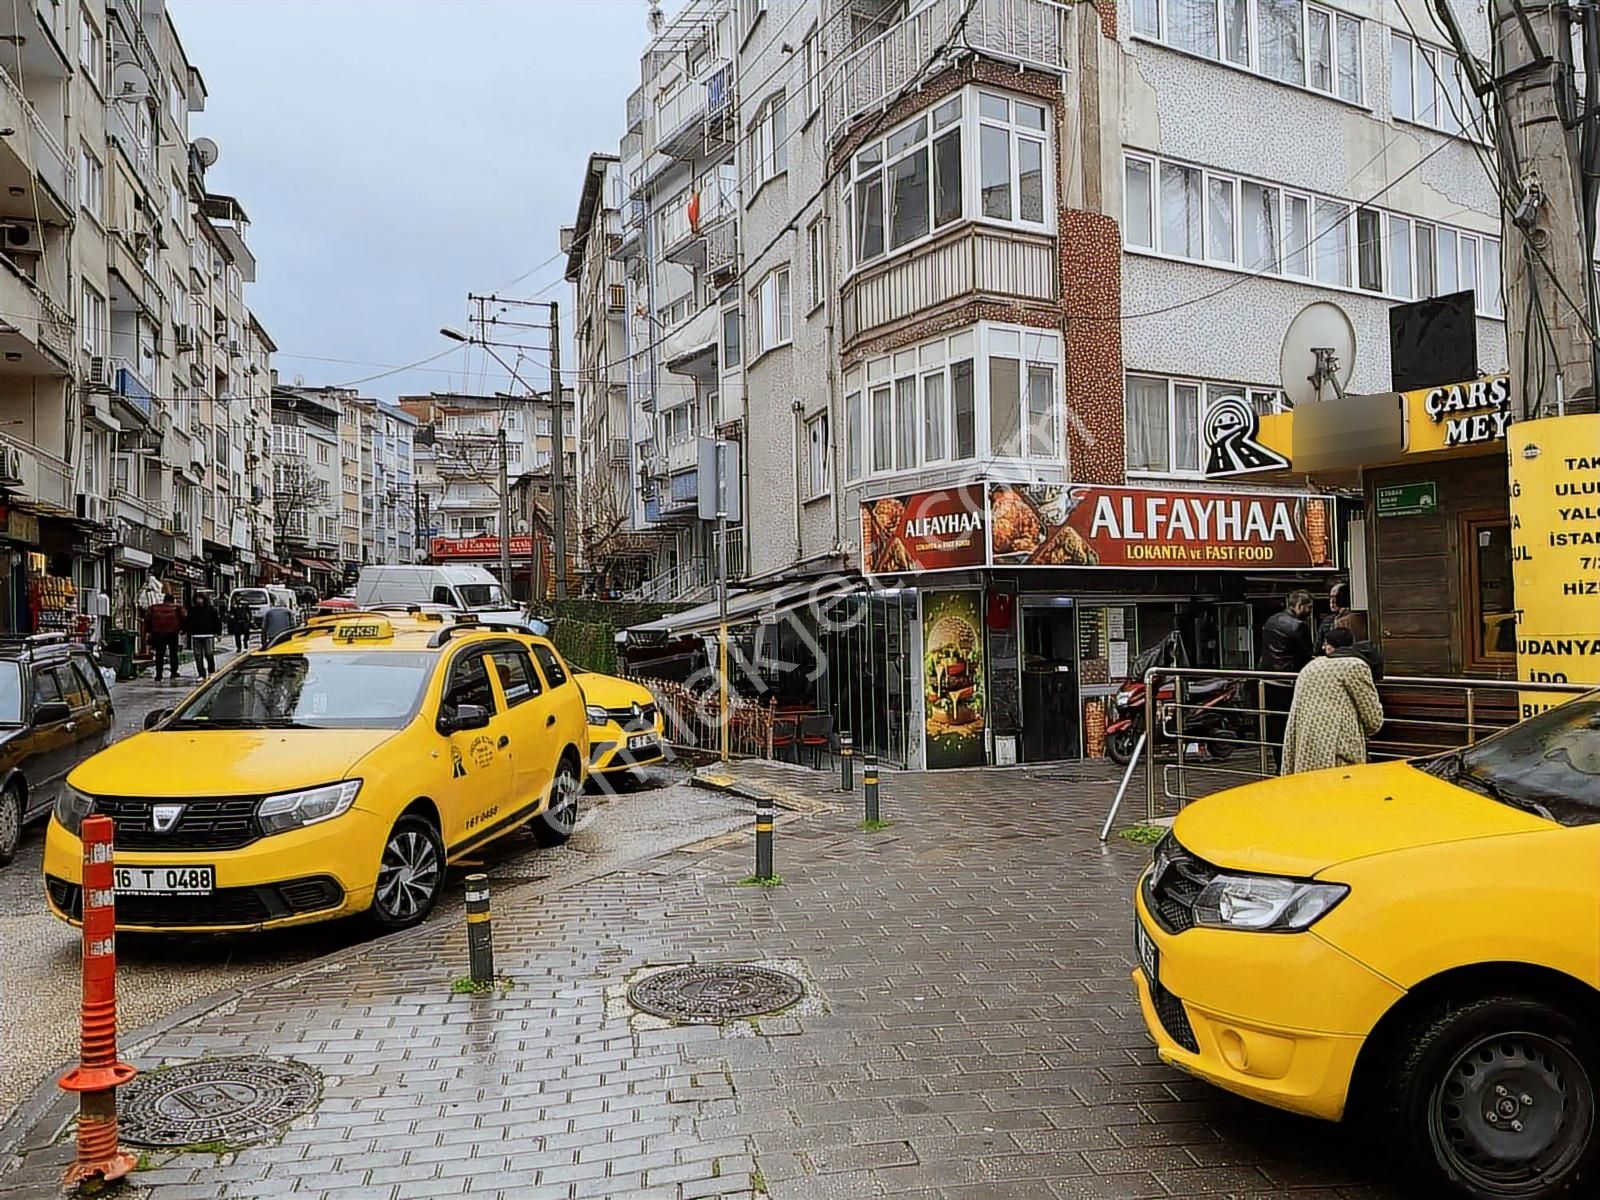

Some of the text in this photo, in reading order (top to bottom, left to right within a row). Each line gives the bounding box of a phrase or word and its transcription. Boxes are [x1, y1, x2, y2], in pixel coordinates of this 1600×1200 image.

[1425, 377, 1511, 421] ÇARŞ
[1555, 482, 1600, 496] ULU
[905, 511, 981, 538] ALFAYHAA
[1090, 495, 1295, 542] ALFAYHAA
[1127, 545, 1187, 560] LOKANTA
[1206, 546, 1234, 560] FAST
[1238, 546, 1273, 561] FOOD
[1563, 580, 1600, 595] HİZ
[114, 870, 210, 888] 16 T 0488
